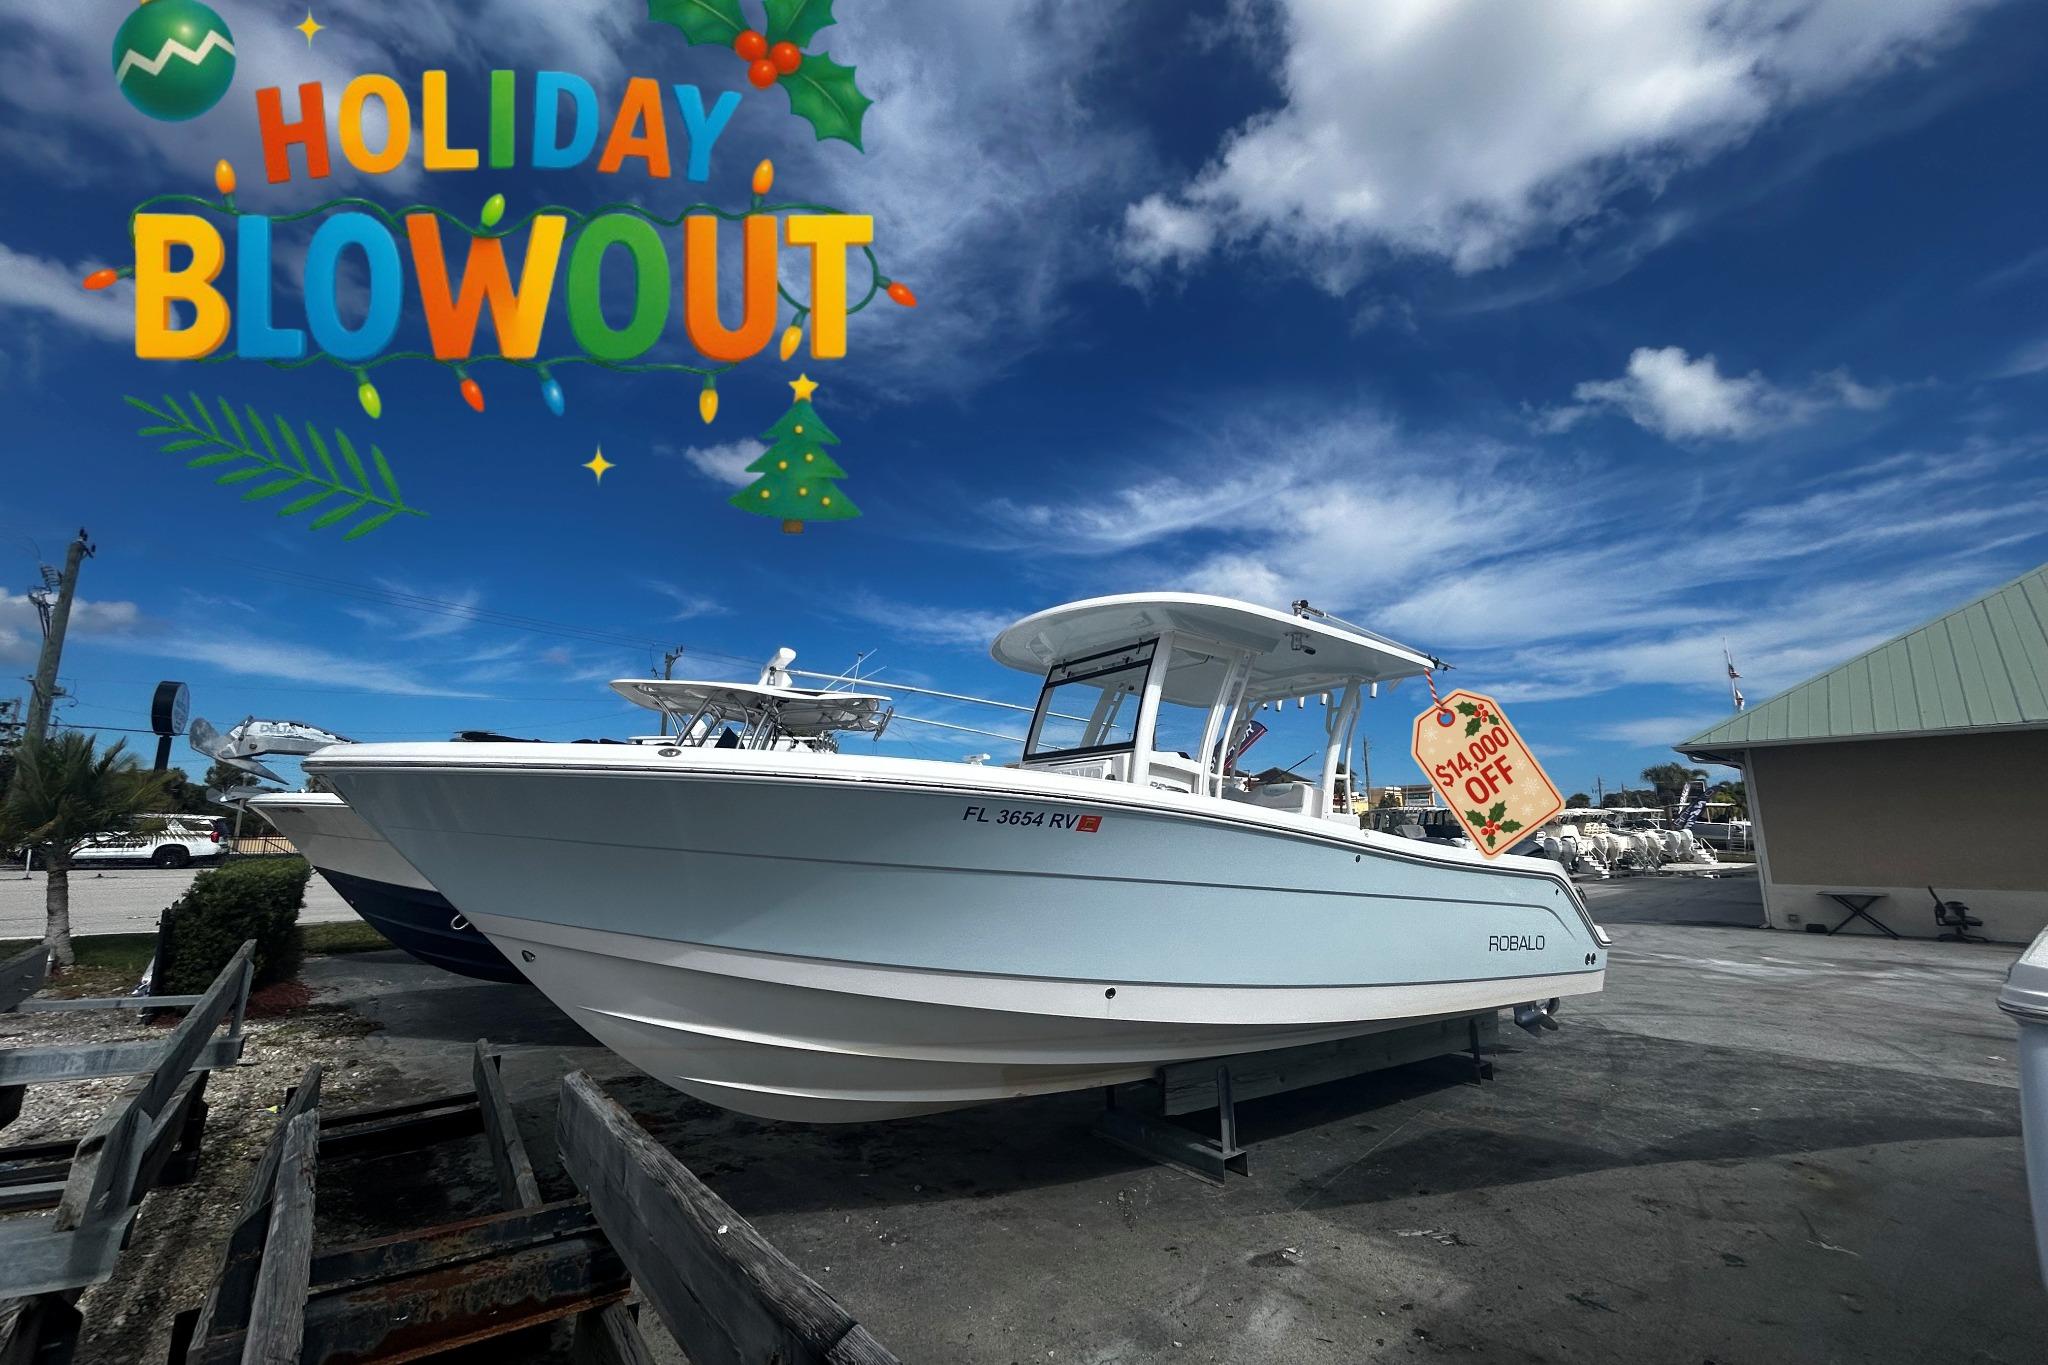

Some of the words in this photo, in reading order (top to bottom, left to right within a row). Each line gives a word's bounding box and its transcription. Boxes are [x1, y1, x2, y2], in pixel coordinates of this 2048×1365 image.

[962, 806, 989, 823] FL
[996, 809, 1045, 827] 3654
[1049, 813, 1079, 829] RV
[1488, 935, 1545, 951] ROBALO
